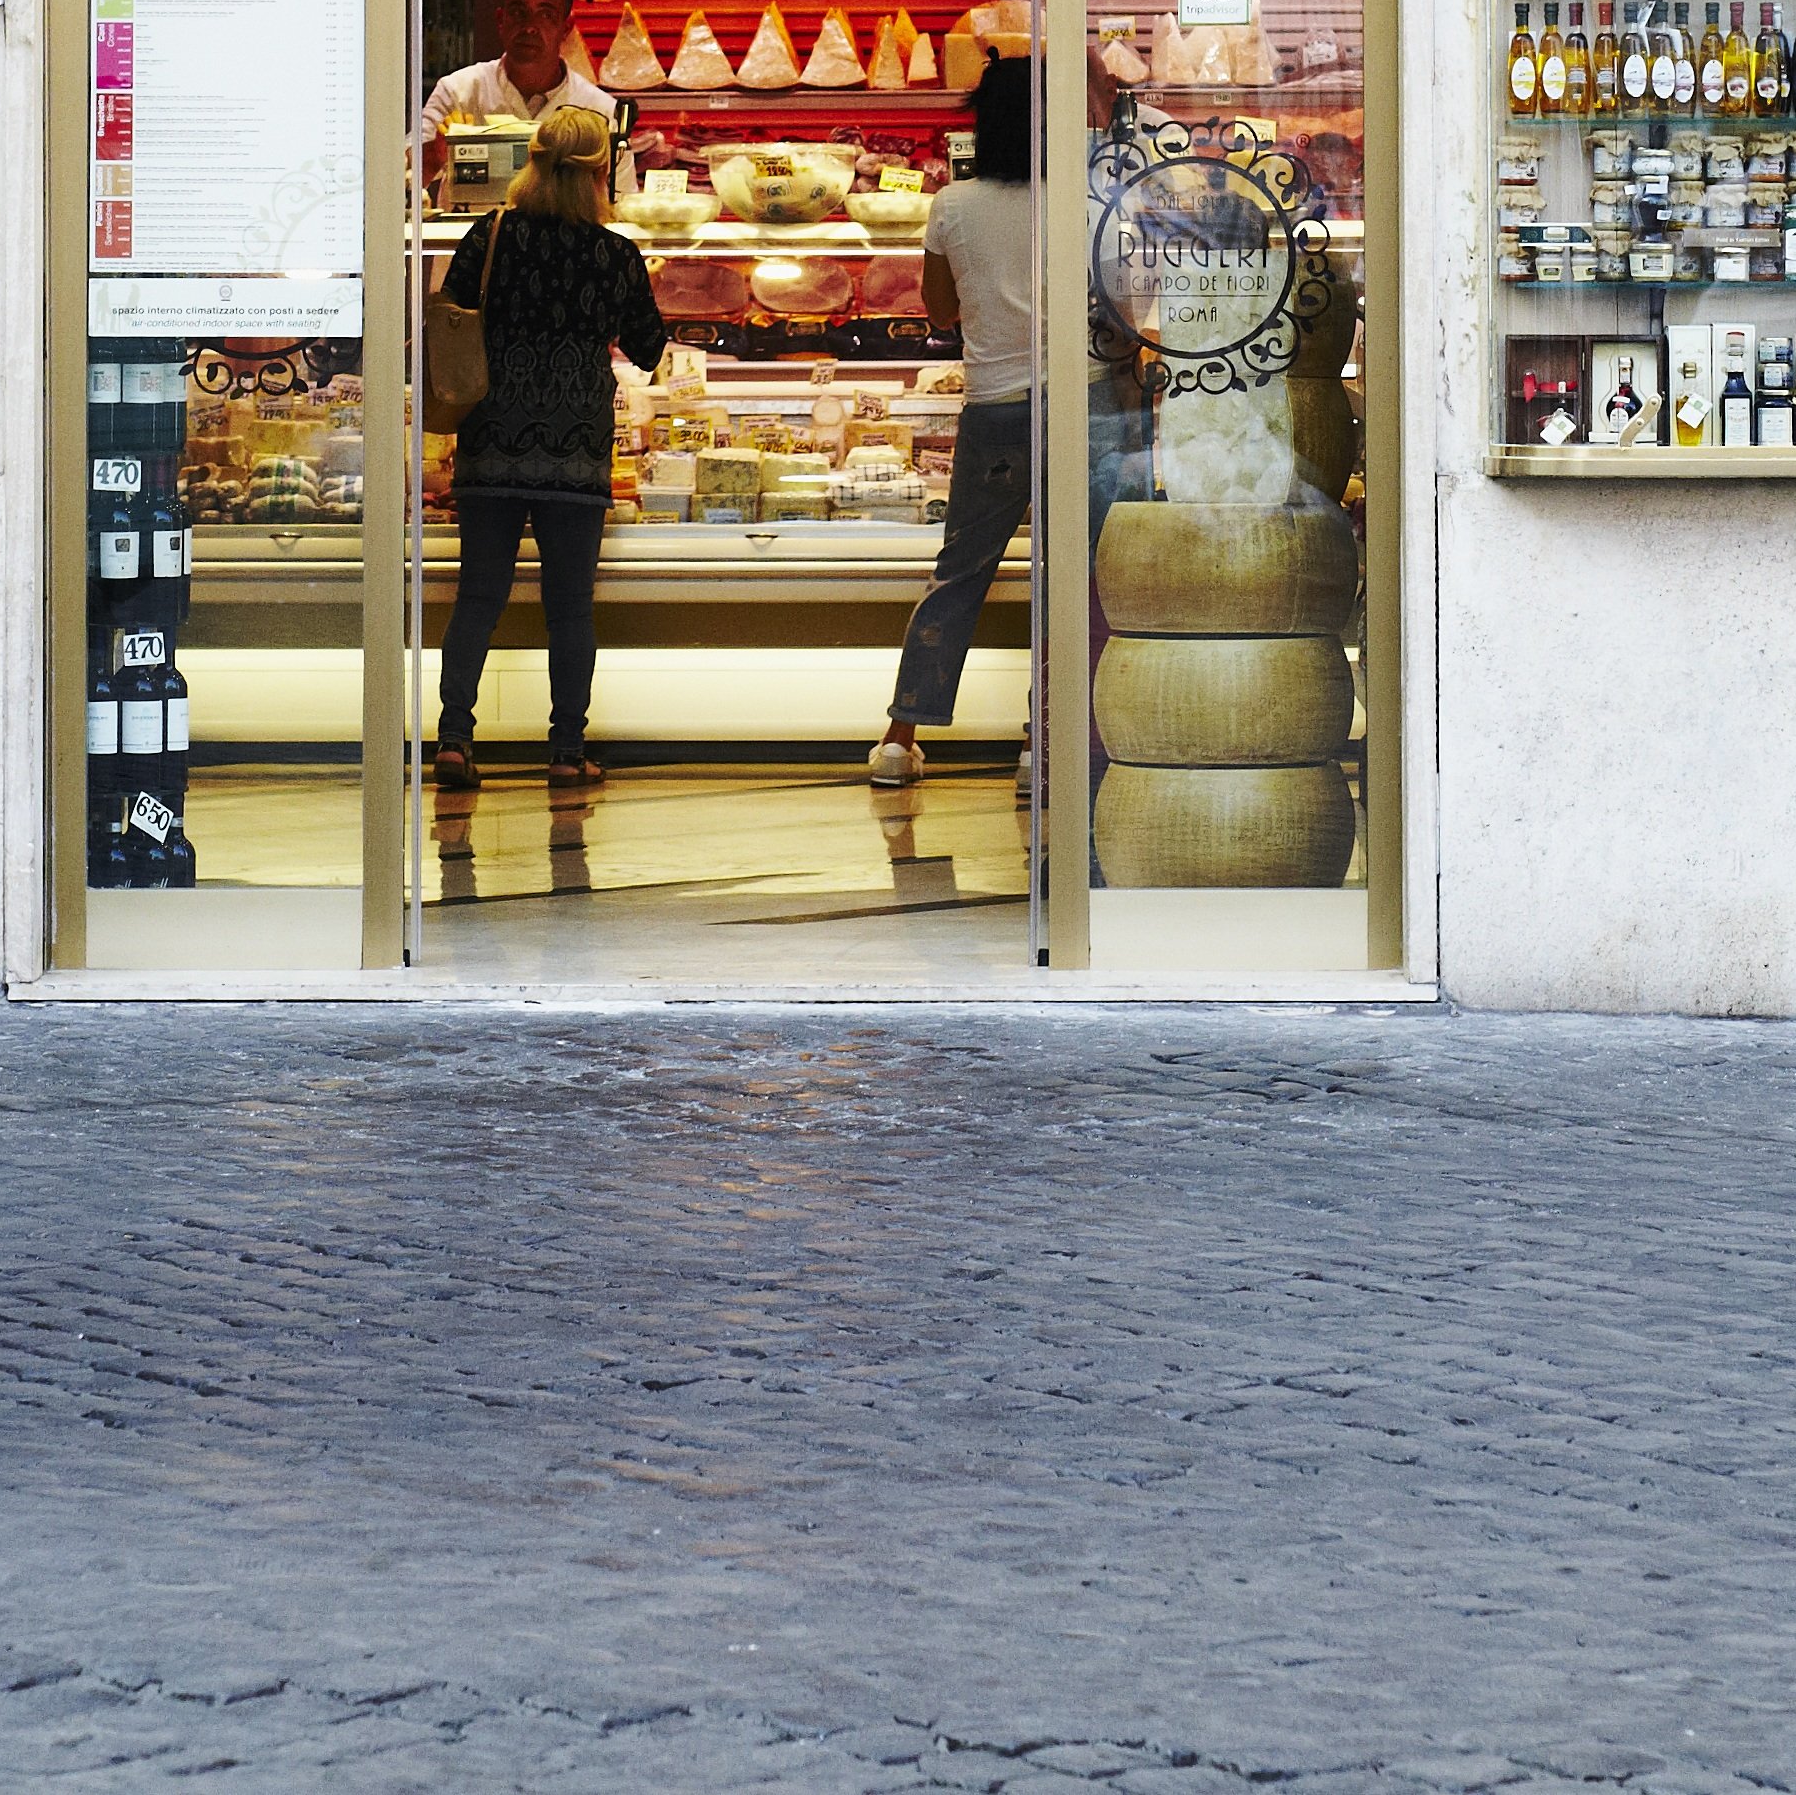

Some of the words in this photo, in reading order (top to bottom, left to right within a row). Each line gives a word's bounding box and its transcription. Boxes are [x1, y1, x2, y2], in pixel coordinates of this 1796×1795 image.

[1186, 4, 1239, 15] tripadvisor
[1117, 230, 1267, 269] RUGGERI
[1132, 275, 1191, 292] CAMPO
[1199, 275, 1217, 291] DE
[1227, 275, 1269, 291] FIORI
[112, 306, 145, 316] spazio
[147, 306, 183, 315] interno
[185, 306, 245, 315] climatizzato
[248, 307, 266, 315] con
[269, 306, 294, 316] posti
[306, 306, 340, 315] sedere
[1168, 306, 1217, 323] ROMA
[131, 319, 201, 328] air-conditioned
[203, 319, 231, 328] indoor
[235, 320, 263, 330] space
[265, 319, 284, 328] with
[287, 319, 321, 330] seating
[95, 461, 139, 487] 470
[124, 636, 164, 661] 470
[136, 796, 170, 833] 650
